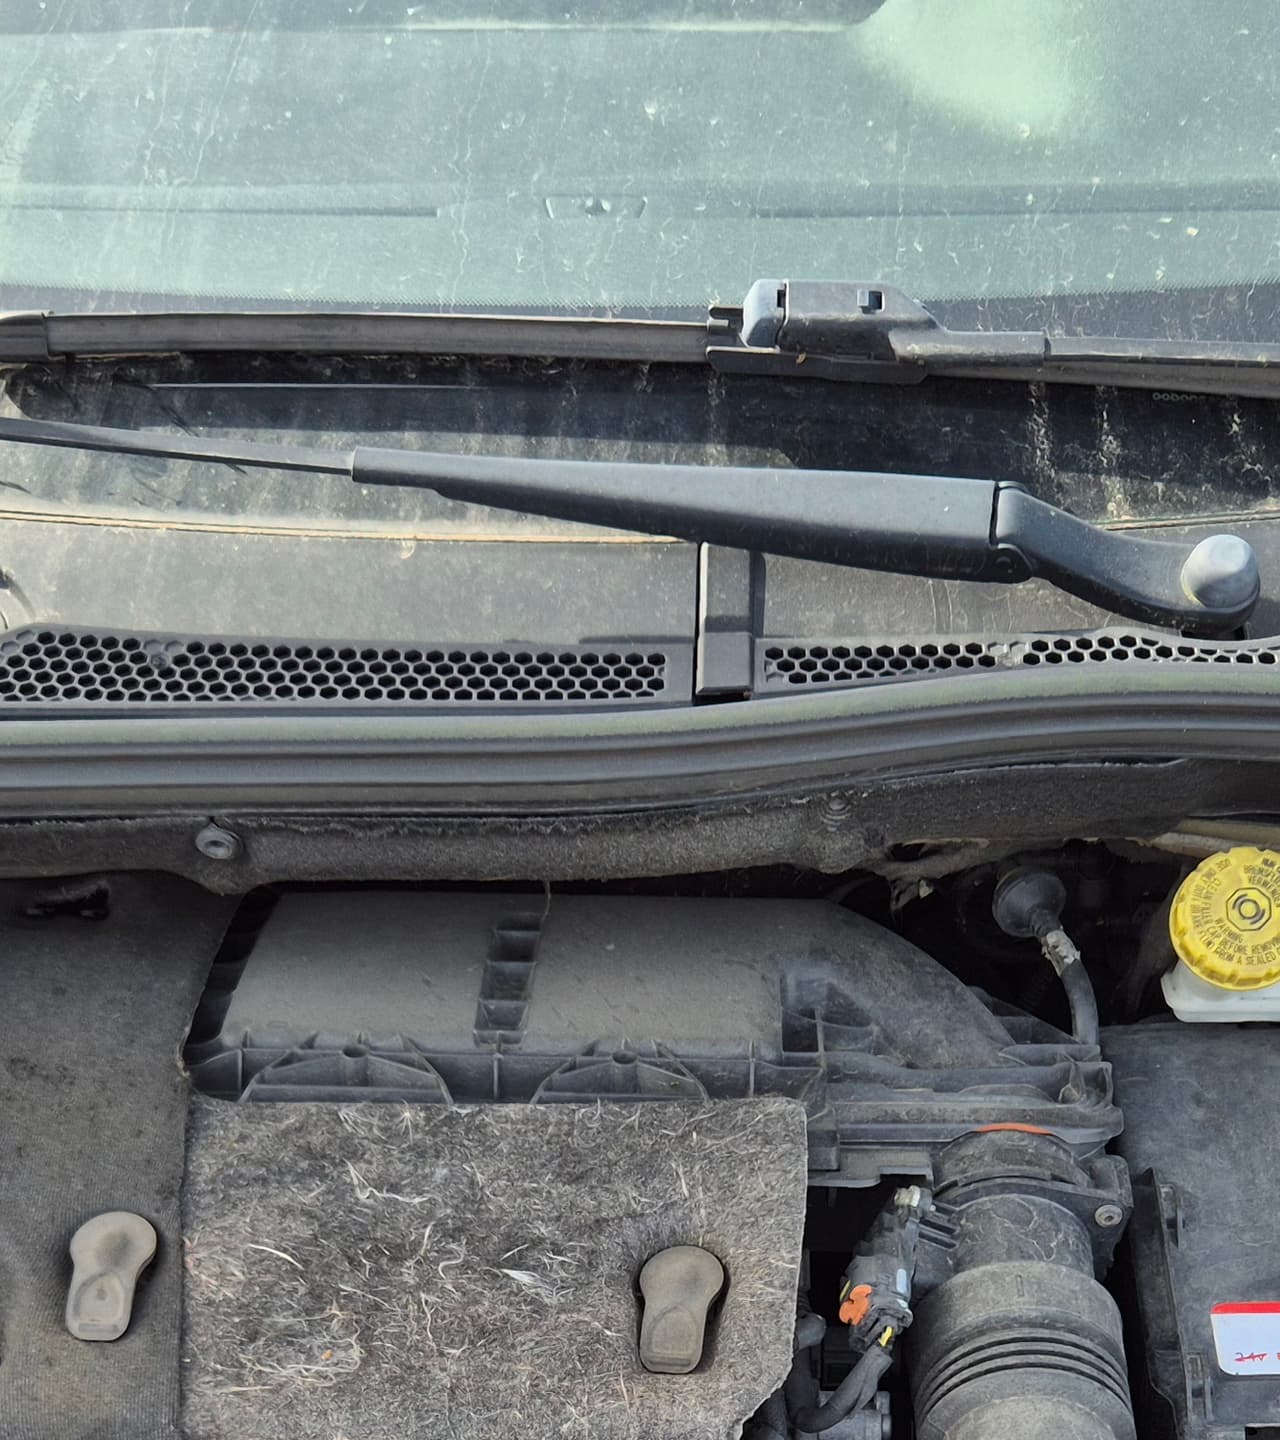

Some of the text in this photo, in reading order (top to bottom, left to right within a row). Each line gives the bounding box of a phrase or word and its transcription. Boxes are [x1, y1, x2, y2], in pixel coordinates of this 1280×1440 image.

[1207, 926, 1222, 939] CAP
[1220, 936, 1248, 955] BEFORE
[1215, 918, 1244, 943] WARNING
[1214, 946, 1234, 962] FROM
[1237, 957, 1242, 966] A
[1245, 952, 1277, 966] SEALED
